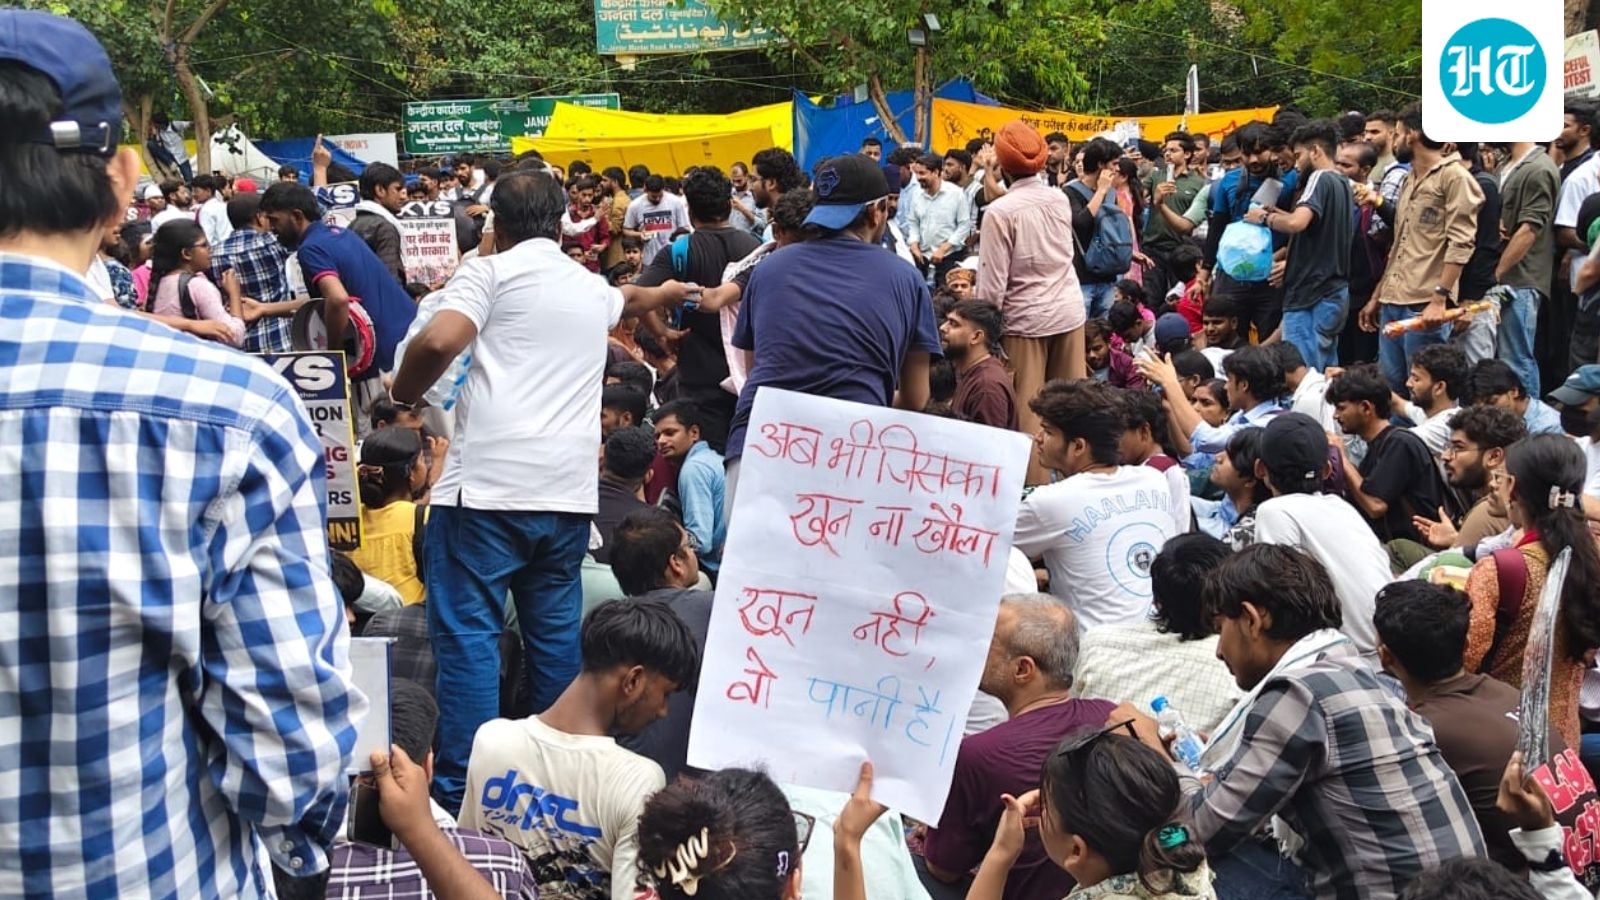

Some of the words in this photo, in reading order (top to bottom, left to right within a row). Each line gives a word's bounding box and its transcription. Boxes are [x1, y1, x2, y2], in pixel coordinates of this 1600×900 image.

[598, 9, 637, 21] जनता
[640, 8, 665, 21] दल
[407, 121, 443, 133] जनता
[444, 119, 465, 132] दल
[750, 421, 823, 467] अब
[827, 419, 880, 479] भी
[877, 424, 1002, 498] जिसका
[790, 493, 864, 557] खून
[868, 505, 912, 547] ना
[1064, 489, 1173, 544] HAALAN
[737, 587, 817, 646] खून
[726, 646, 778, 710] वो
[806, 676, 904, 730] पानी
